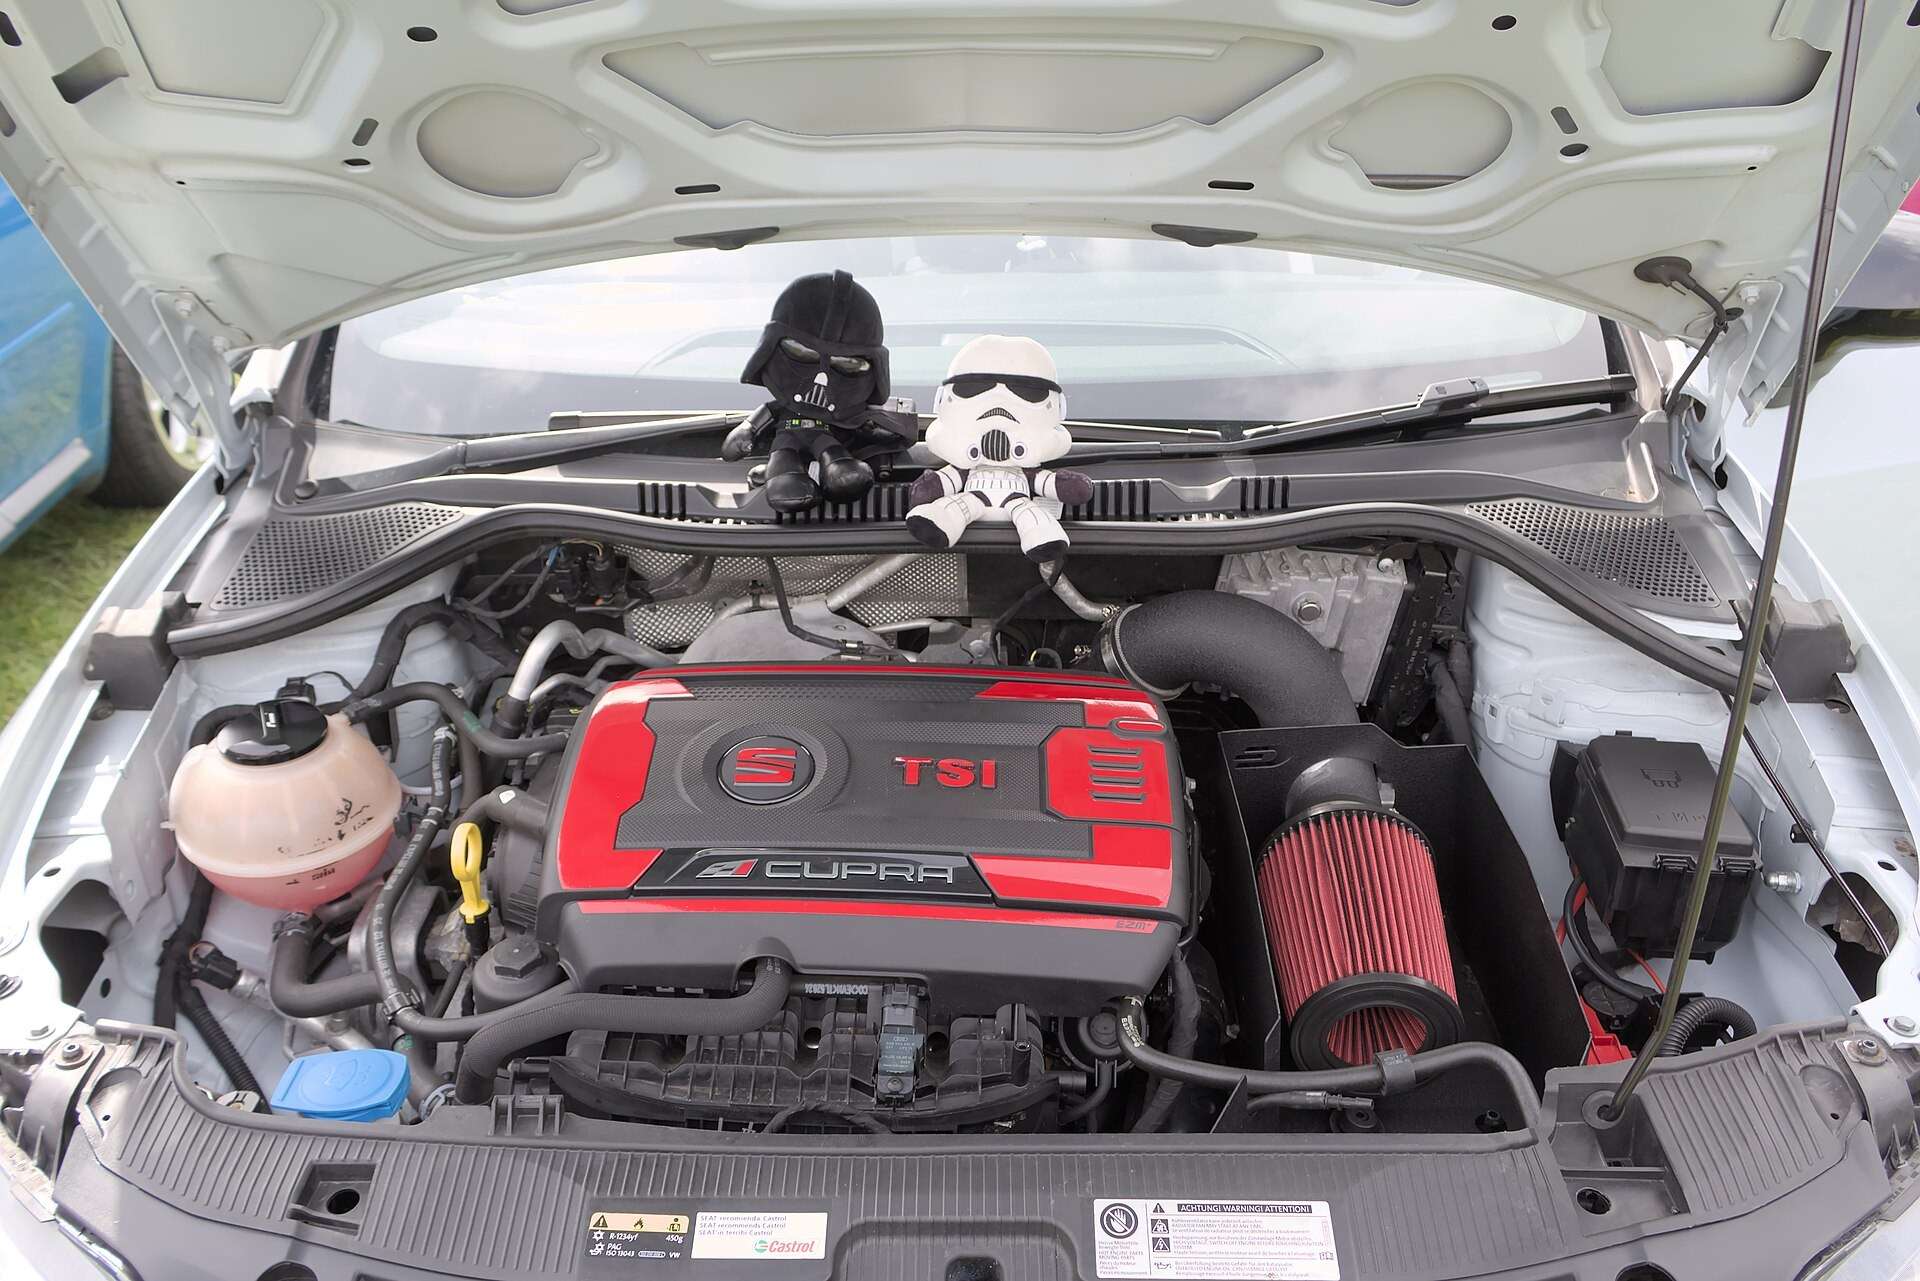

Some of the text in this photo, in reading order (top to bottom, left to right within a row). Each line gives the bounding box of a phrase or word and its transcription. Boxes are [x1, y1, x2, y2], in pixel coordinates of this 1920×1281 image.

[894, 756, 998, 788] TSI
[765, 860, 954, 884] CUPRA
[1180, 1203, 1310, 1214] ACHTUNG! WARNING! ATTENTION!
[609, 1232, 684, 1244] R-1234yf 450g
[606, 1242, 622, 1251] PAG
[769, 1239, 816, 1254] Castrol
[669, 1251, 681, 1259] VW
